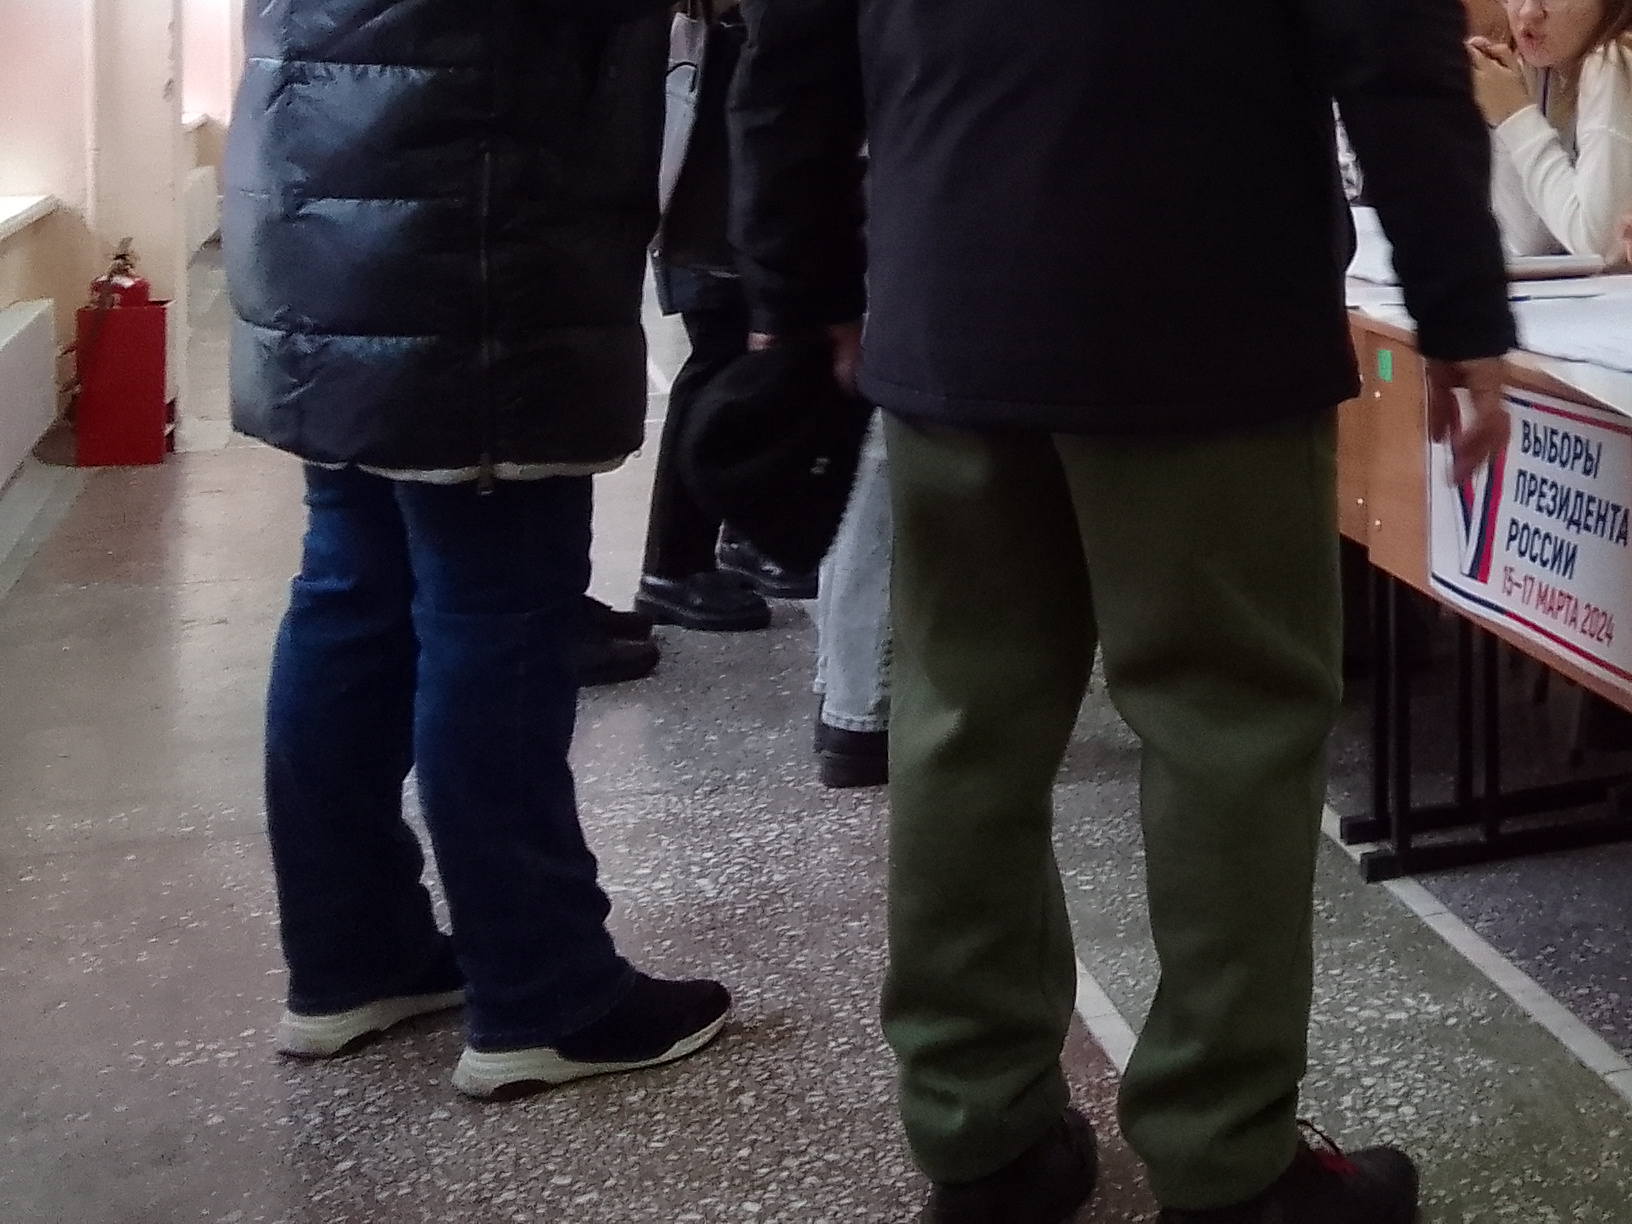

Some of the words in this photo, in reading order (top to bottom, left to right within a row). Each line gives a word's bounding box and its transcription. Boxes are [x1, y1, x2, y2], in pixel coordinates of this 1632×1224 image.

[1520, 419, 1603, 479] ВЫБОРЫ
[1513, 468, 1631, 547] ПРЕЗИДЕНТА
[1504, 517, 1579, 580] РОССИИ
[1535, 581, 1579, 630] МАРТА
[1580, 603, 1616, 648] 2024
